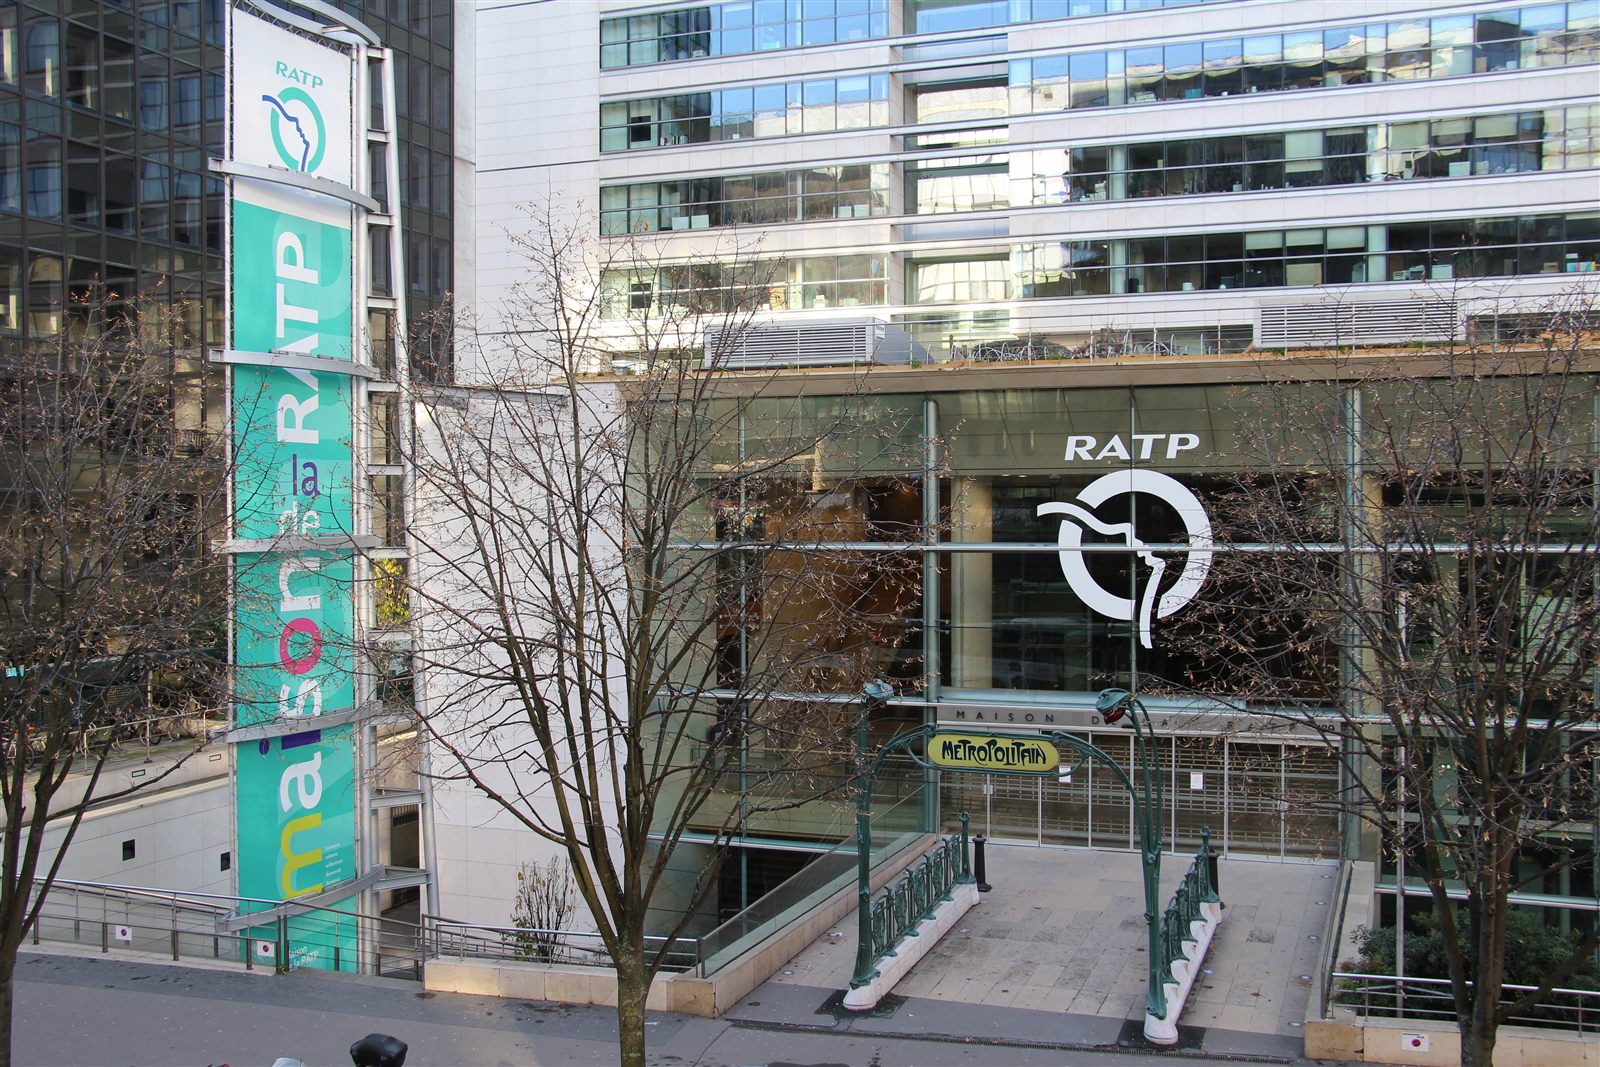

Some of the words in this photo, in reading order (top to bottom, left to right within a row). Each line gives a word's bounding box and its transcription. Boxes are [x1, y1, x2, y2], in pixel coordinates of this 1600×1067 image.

[276, 60, 324, 89] RATP
[275, 231, 320, 445] RATP
[1064, 433, 1200, 461] RATP
[292, 453, 321, 496] la
[956, 710, 1055, 723] MAISON
[941, 739, 1047, 766] METROPOLITAIN
